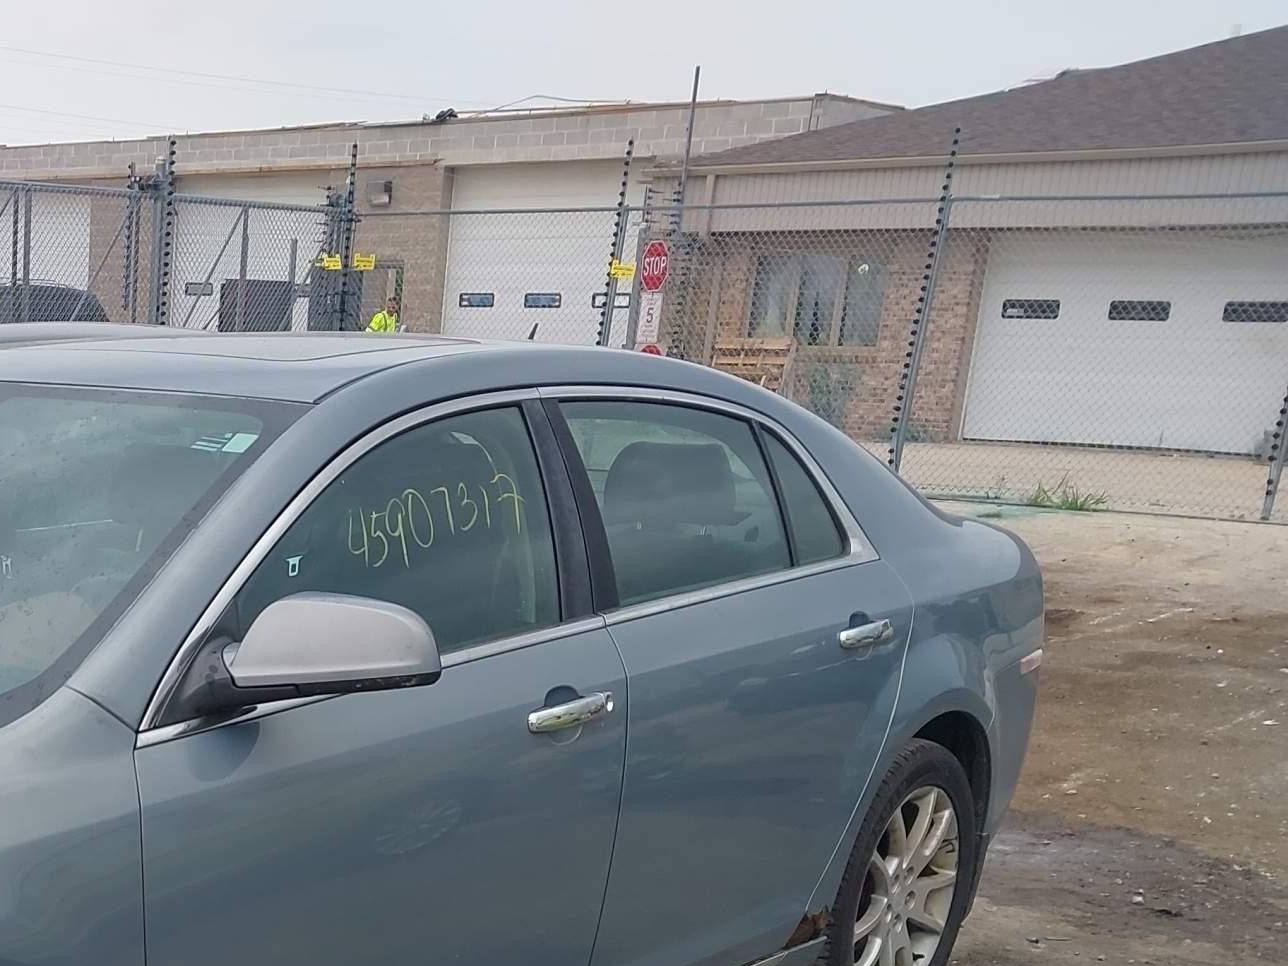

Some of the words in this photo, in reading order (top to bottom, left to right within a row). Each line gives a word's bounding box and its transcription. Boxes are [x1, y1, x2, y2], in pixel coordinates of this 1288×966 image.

[643, 256, 667, 276] STOP
[646, 308, 654, 323] 5
[347, 473, 527, 569] 45907317
